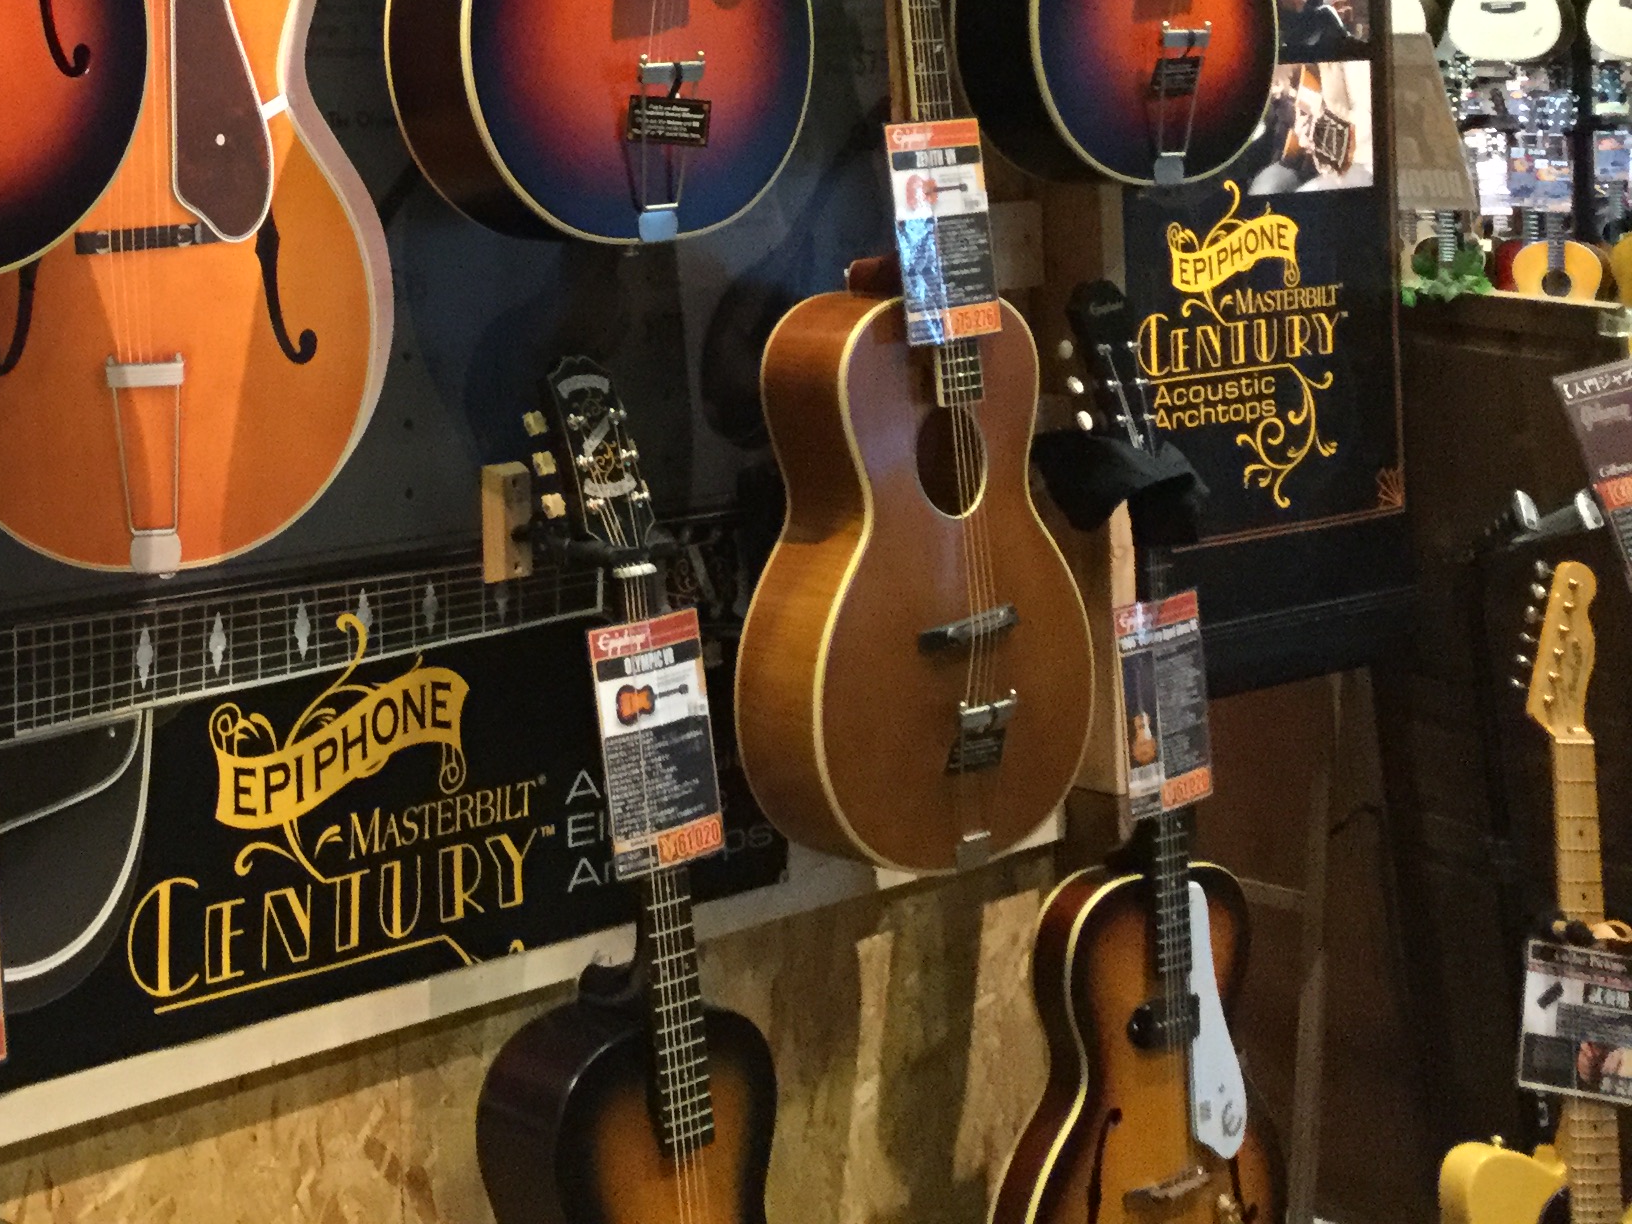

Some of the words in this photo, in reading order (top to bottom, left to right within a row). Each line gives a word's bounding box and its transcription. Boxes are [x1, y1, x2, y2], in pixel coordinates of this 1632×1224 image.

[1178, 222, 1290, 287] EPIPHONE
[1153, 373, 1277, 408] Acoustic
[1154, 397, 1278, 432] Archtops
[232, 681, 454, 817] EPIPHONE
